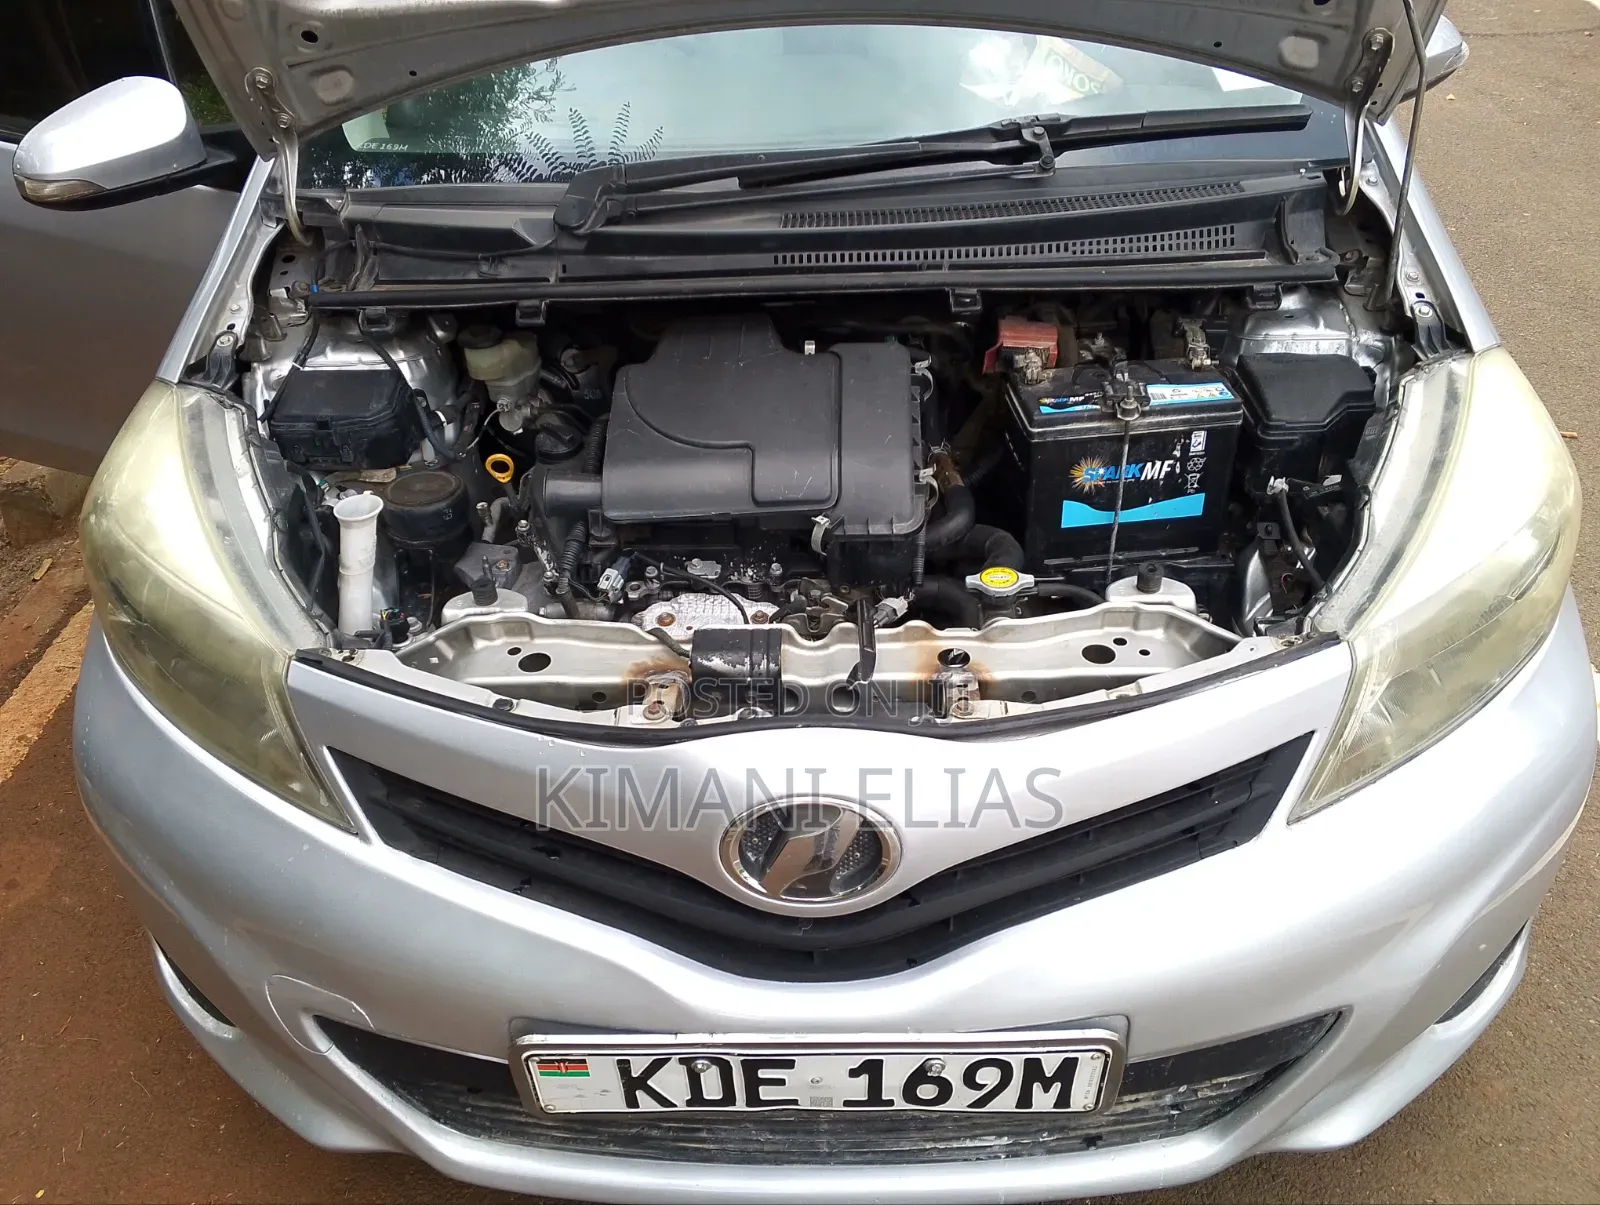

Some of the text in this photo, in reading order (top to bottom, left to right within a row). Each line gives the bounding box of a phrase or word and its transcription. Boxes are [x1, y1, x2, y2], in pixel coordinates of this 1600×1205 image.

[380, 143, 408, 151] 169M
[616, 1055, 801, 1109] KDE
[842, 1056, 1080, 1110] 169M
